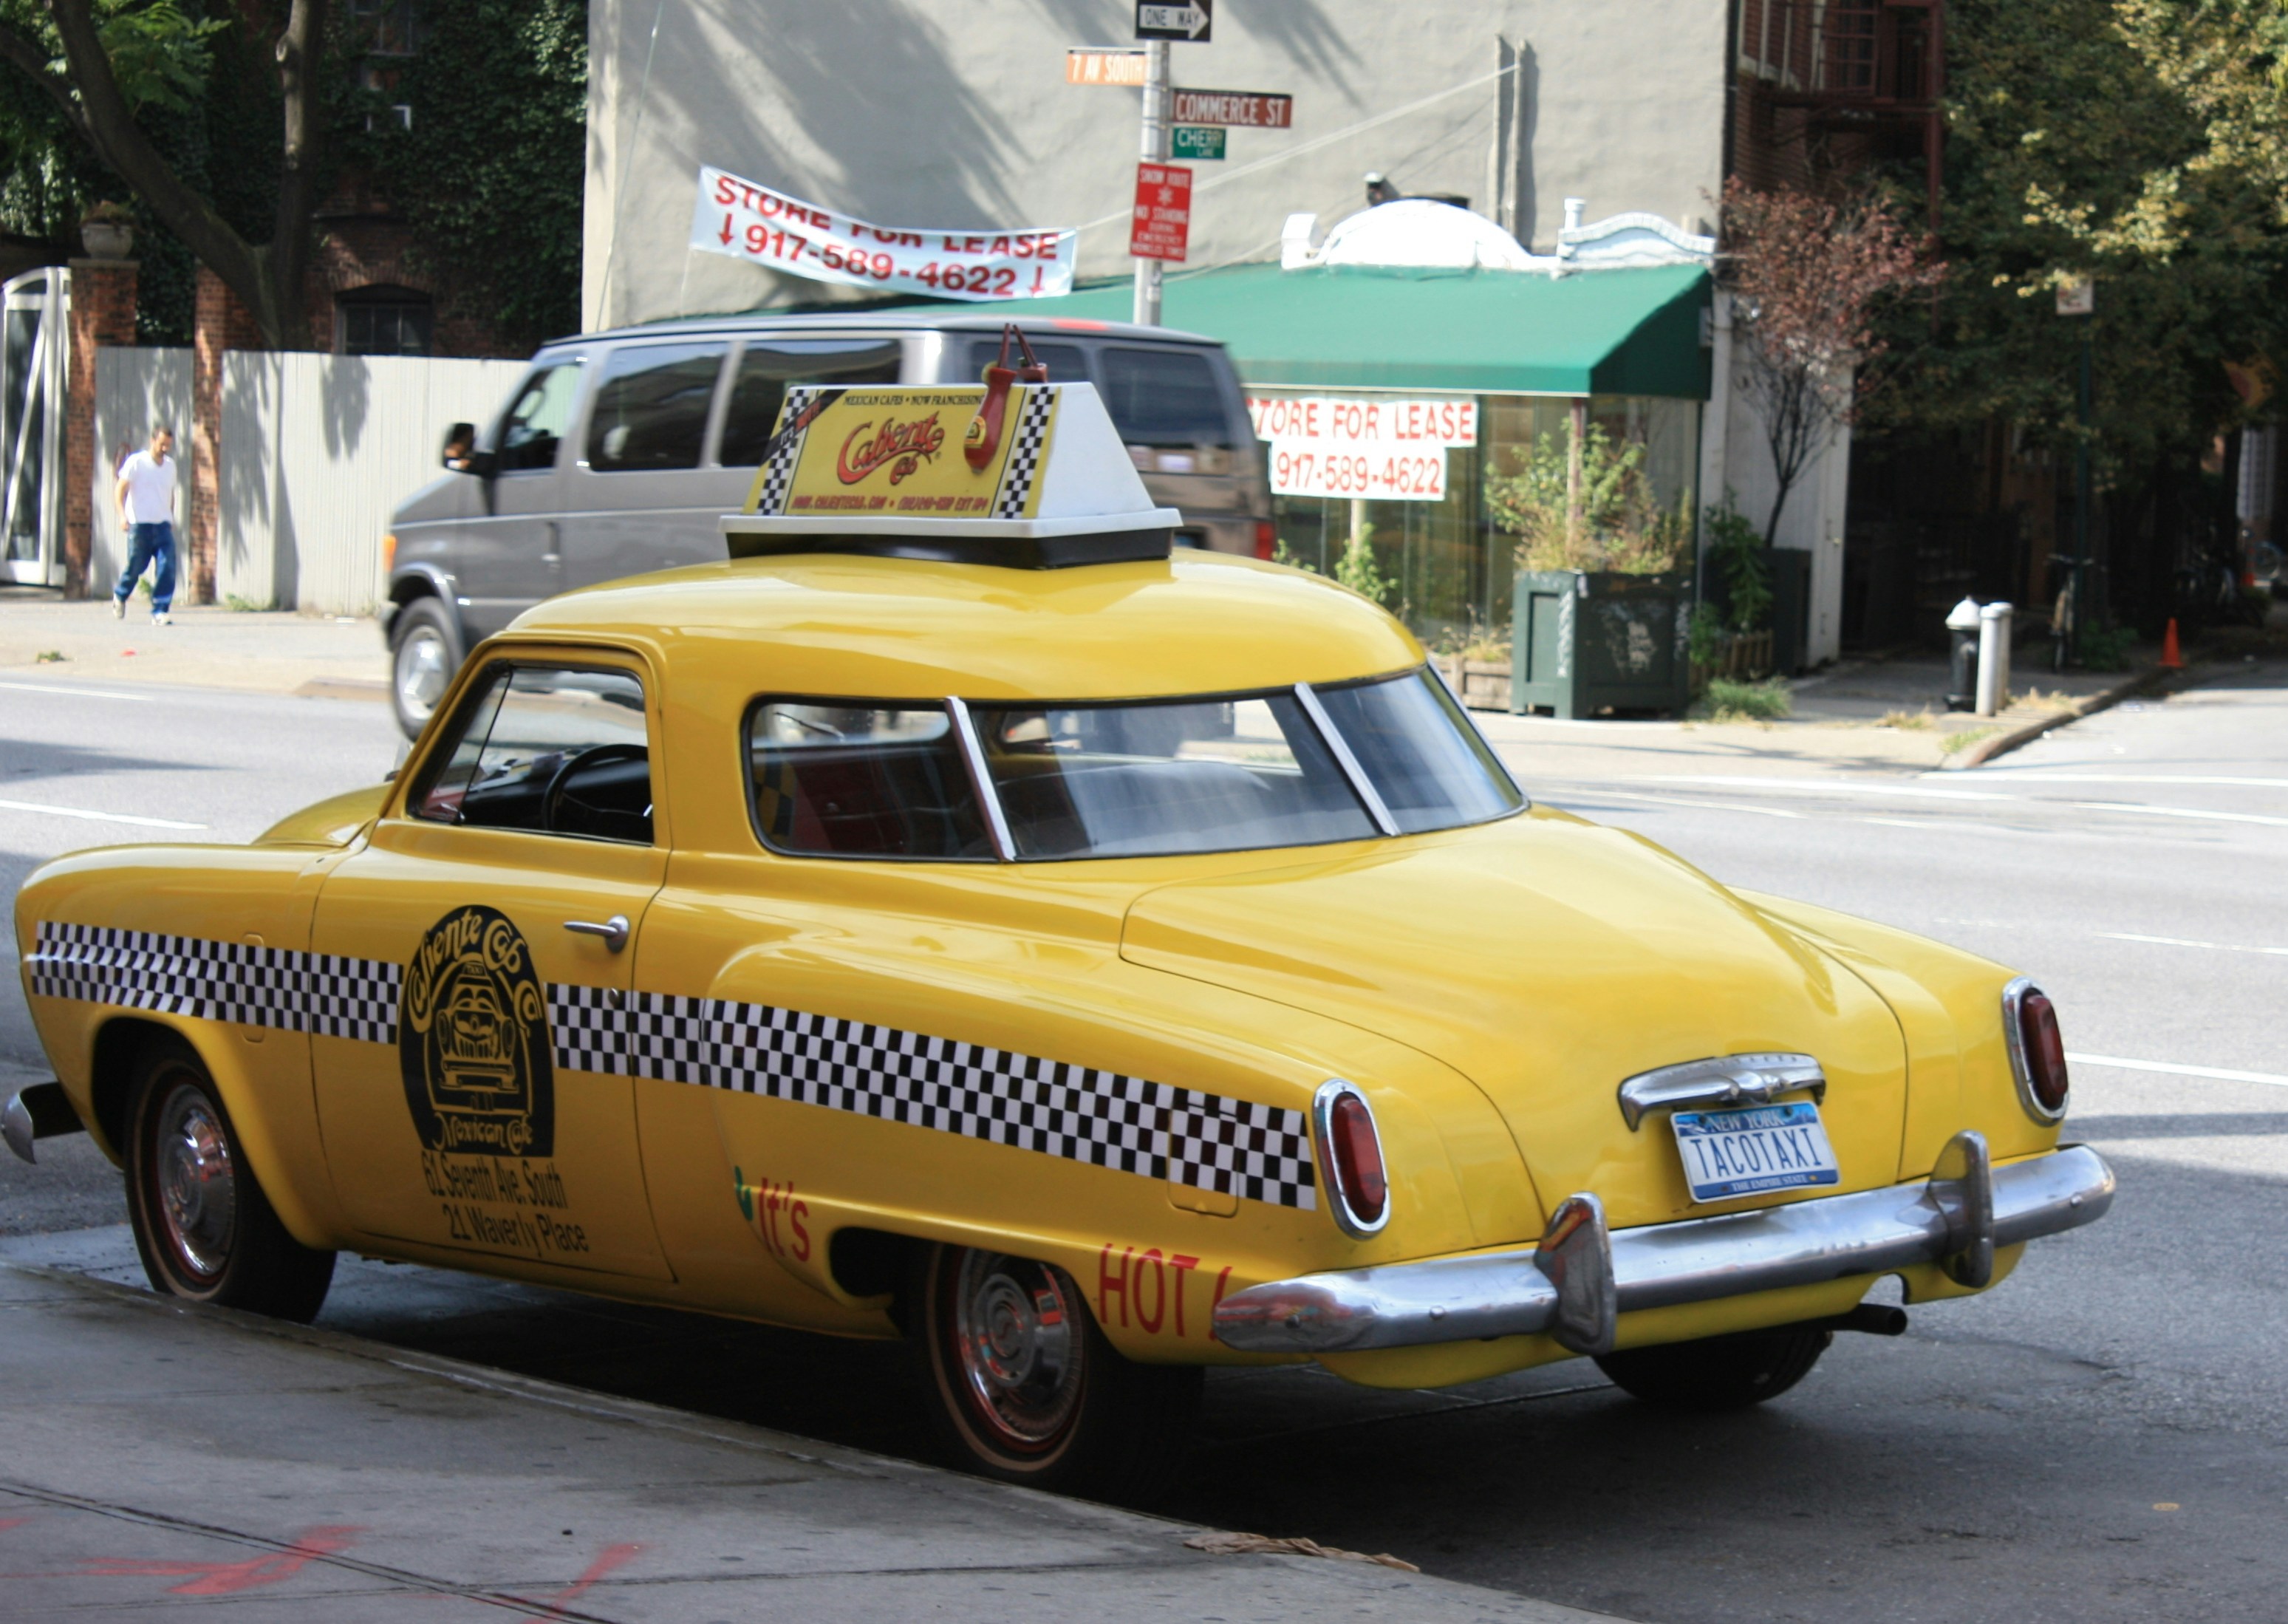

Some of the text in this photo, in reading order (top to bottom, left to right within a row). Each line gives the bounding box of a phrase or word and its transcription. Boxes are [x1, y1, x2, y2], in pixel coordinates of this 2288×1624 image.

[1145, 8, 1200, 27] ONE WAY
[1072, 55, 1082, 81] 7
[1084, 55, 1102, 82] AV
[1175, 93, 1285, 126] COMMERCE ST
[715, 176, 830, 231] STORE
[943, 233, 1059, 259] LEASE
[745, 224, 1017, 296] 917-589-4622
[1246, 397, 1473, 440] TORE FOR LEASE
[837, 410, 946, 485] Caliente
[1277, 451, 1441, 494] 917-589-4622
[408, 907, 483, 1034] Caliente
[432, 1111, 506, 1152] Mexican
[1707, 1110, 1786, 1133] NEW YORK
[1690, 1127, 1823, 1179] TACOTAXI
[421, 1150, 447, 1197] 61
[441, 1150, 499, 1202] Seventh
[522, 1159, 568, 1210] South
[1732, 1182, 1750, 1193] THE
[442, 1203, 590, 1258] 21 Waverly Place
[758, 1176, 810, 1263] It's
